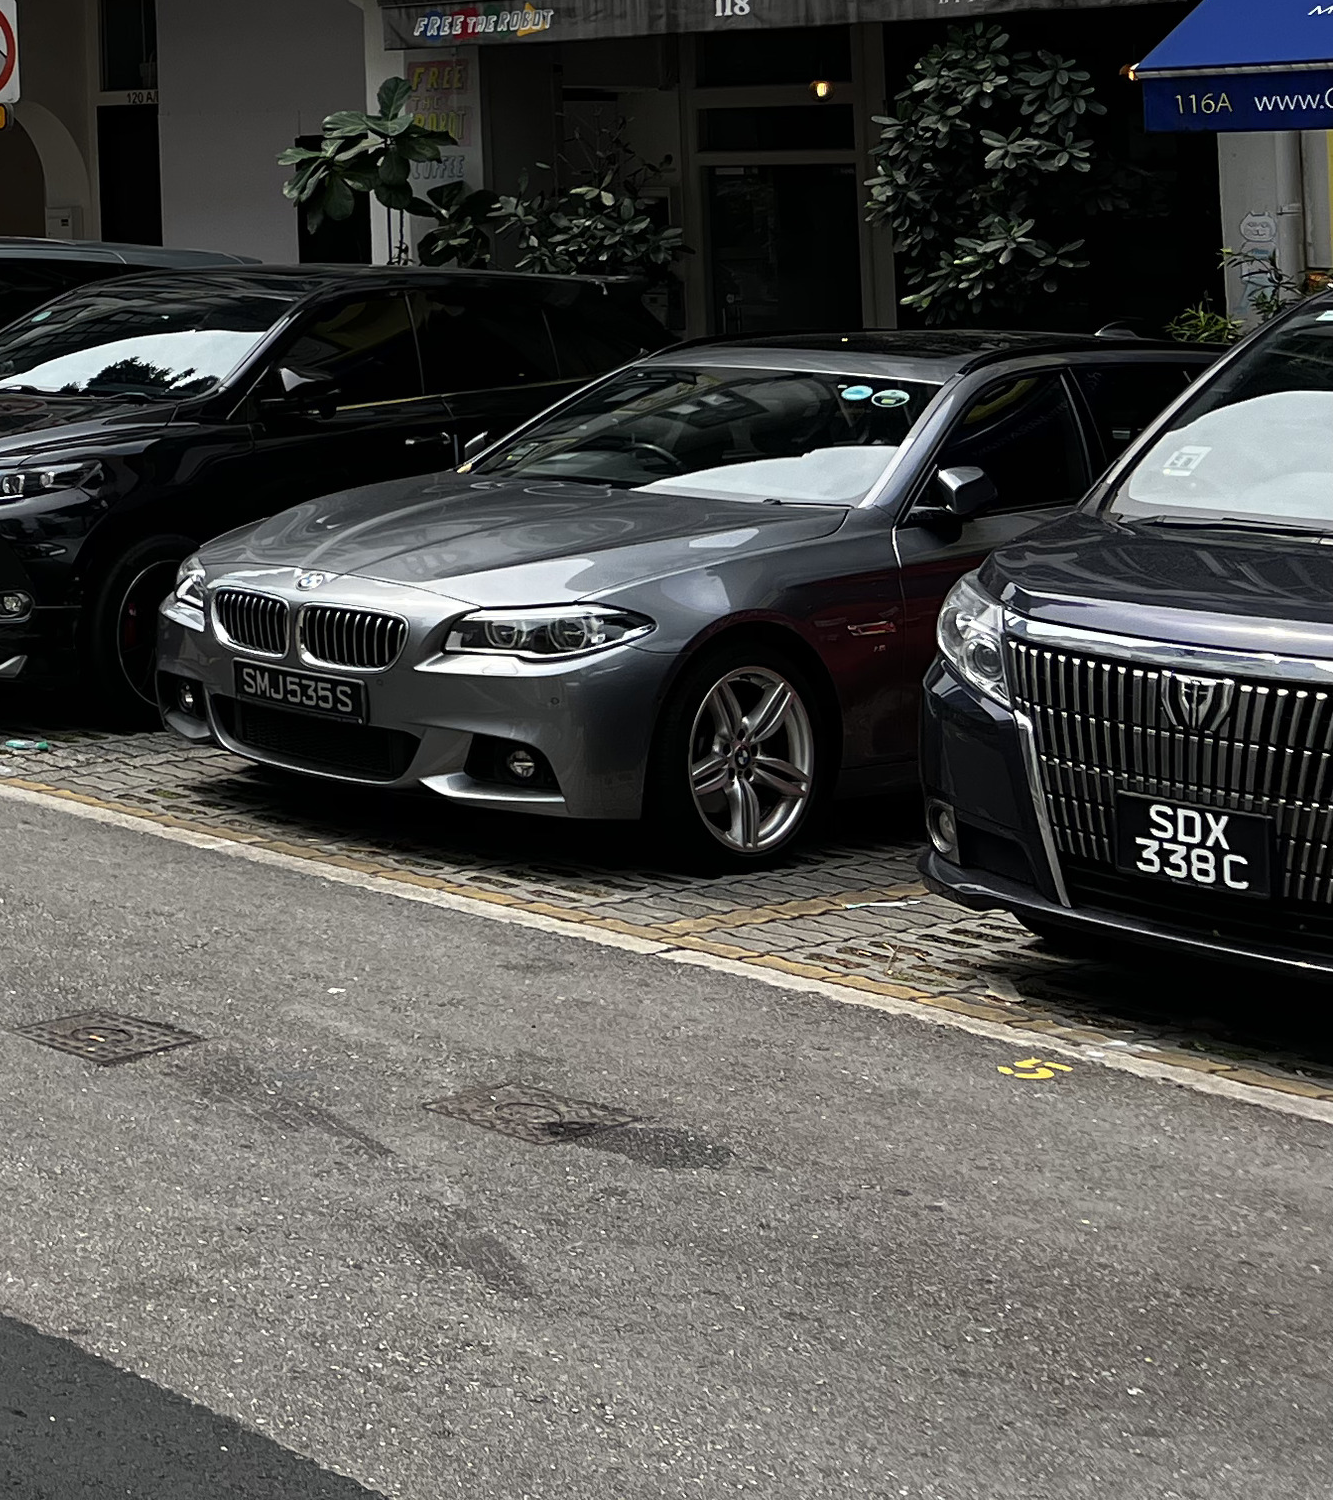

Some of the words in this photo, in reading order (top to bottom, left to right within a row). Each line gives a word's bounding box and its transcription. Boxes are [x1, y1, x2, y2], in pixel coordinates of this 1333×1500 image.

[413, 14, 465, 37] FREE
[497, 8, 555, 33] ROBOT
[412, 65, 466, 92] FREE
[126, 91, 144, 104] 120
[1175, 92, 1233, 114] 116A
[242, 667, 353, 713] SMJ535S
[1149, 803, 1231, 851] SDX
[1135, 836, 1250, 890] 338C
